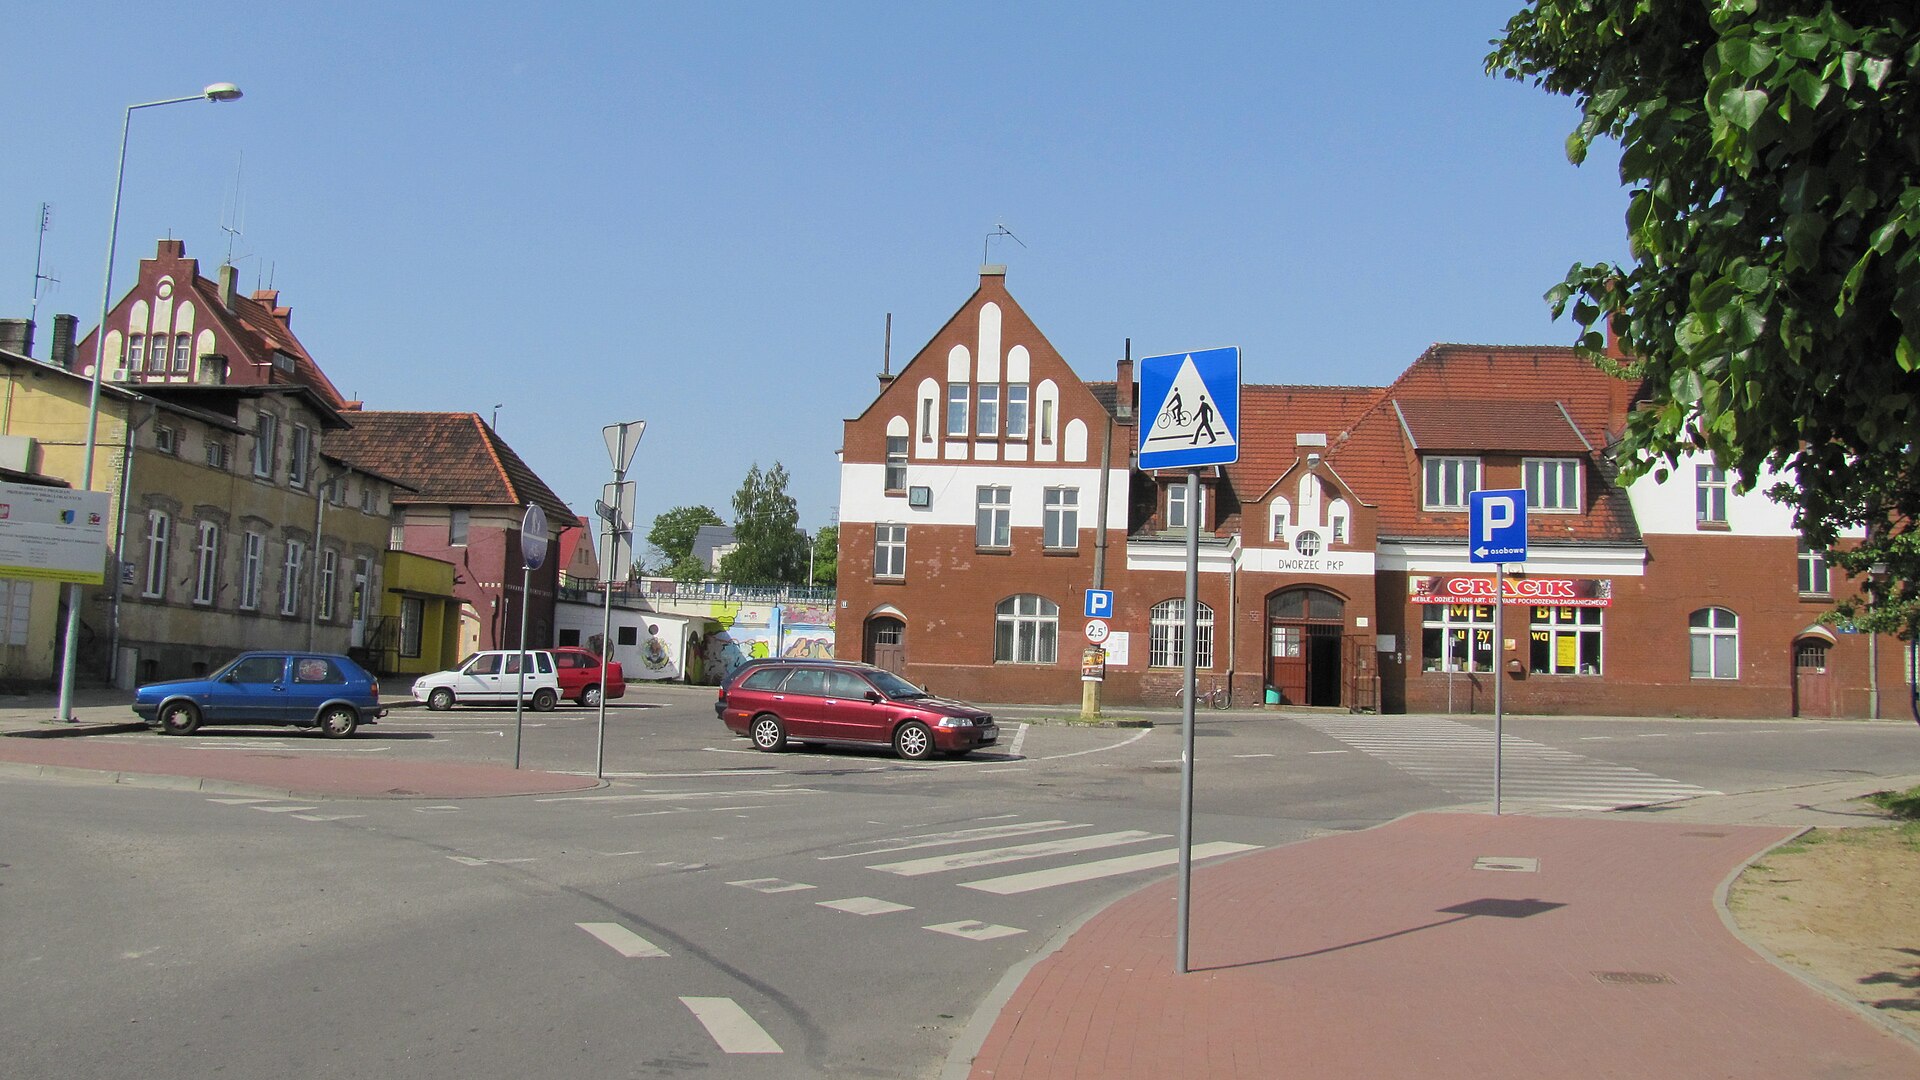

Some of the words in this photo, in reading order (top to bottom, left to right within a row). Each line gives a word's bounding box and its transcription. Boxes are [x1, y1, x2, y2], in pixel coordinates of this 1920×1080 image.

[1482, 496, 1515, 542] P
[1490, 546, 1524, 555] osobowe
[1278, 559, 1320, 570] DWORZEC
[1326, 560, 1345, 571] PKP
[1447, 577, 1575, 598] GRACIK
[1091, 592, 1107, 614] P
[1434, 595, 1455, 603] ODZIEŻ
